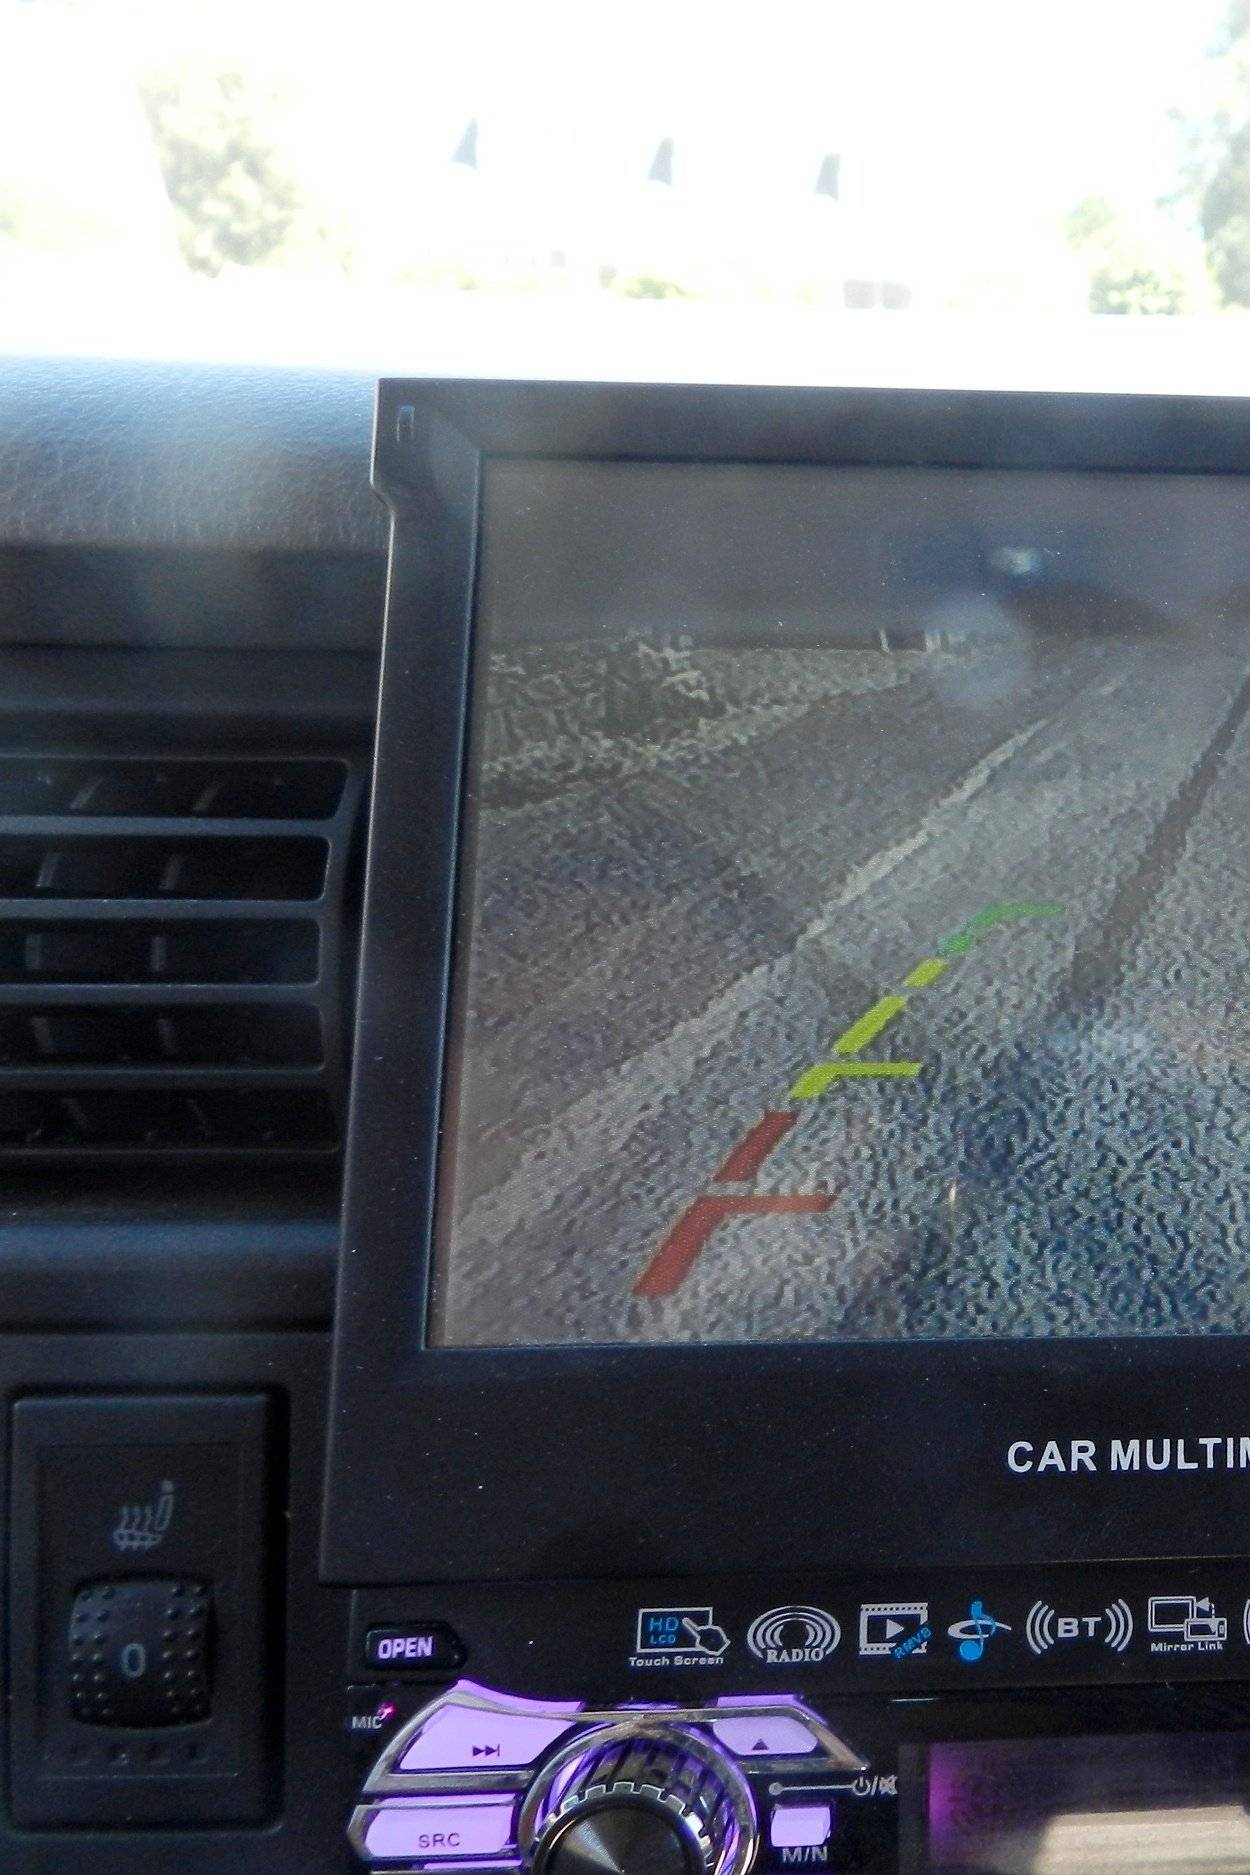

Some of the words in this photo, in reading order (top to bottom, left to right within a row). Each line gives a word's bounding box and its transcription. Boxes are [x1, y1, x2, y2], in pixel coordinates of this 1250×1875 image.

[1007, 1439, 1097, 1474] CAR
[649, 1617, 679, 1632] HD
[1057, 1617, 1102, 1638] BT
[650, 1633, 676, 1645] LCD
[1150, 1642, 1195, 1653] Mirror
[1198, 1640, 1224, 1652] Link
[378, 1636, 434, 1660] OPEN
[766, 1648, 824, 1663] RADIO
[629, 1657, 670, 1667] Touch
[673, 1656, 724, 1667] Screen
[352, 1714, 382, 1729] MIC
[418, 1832, 461, 1849] SRC
[782, 1846, 828, 1863] M/N
